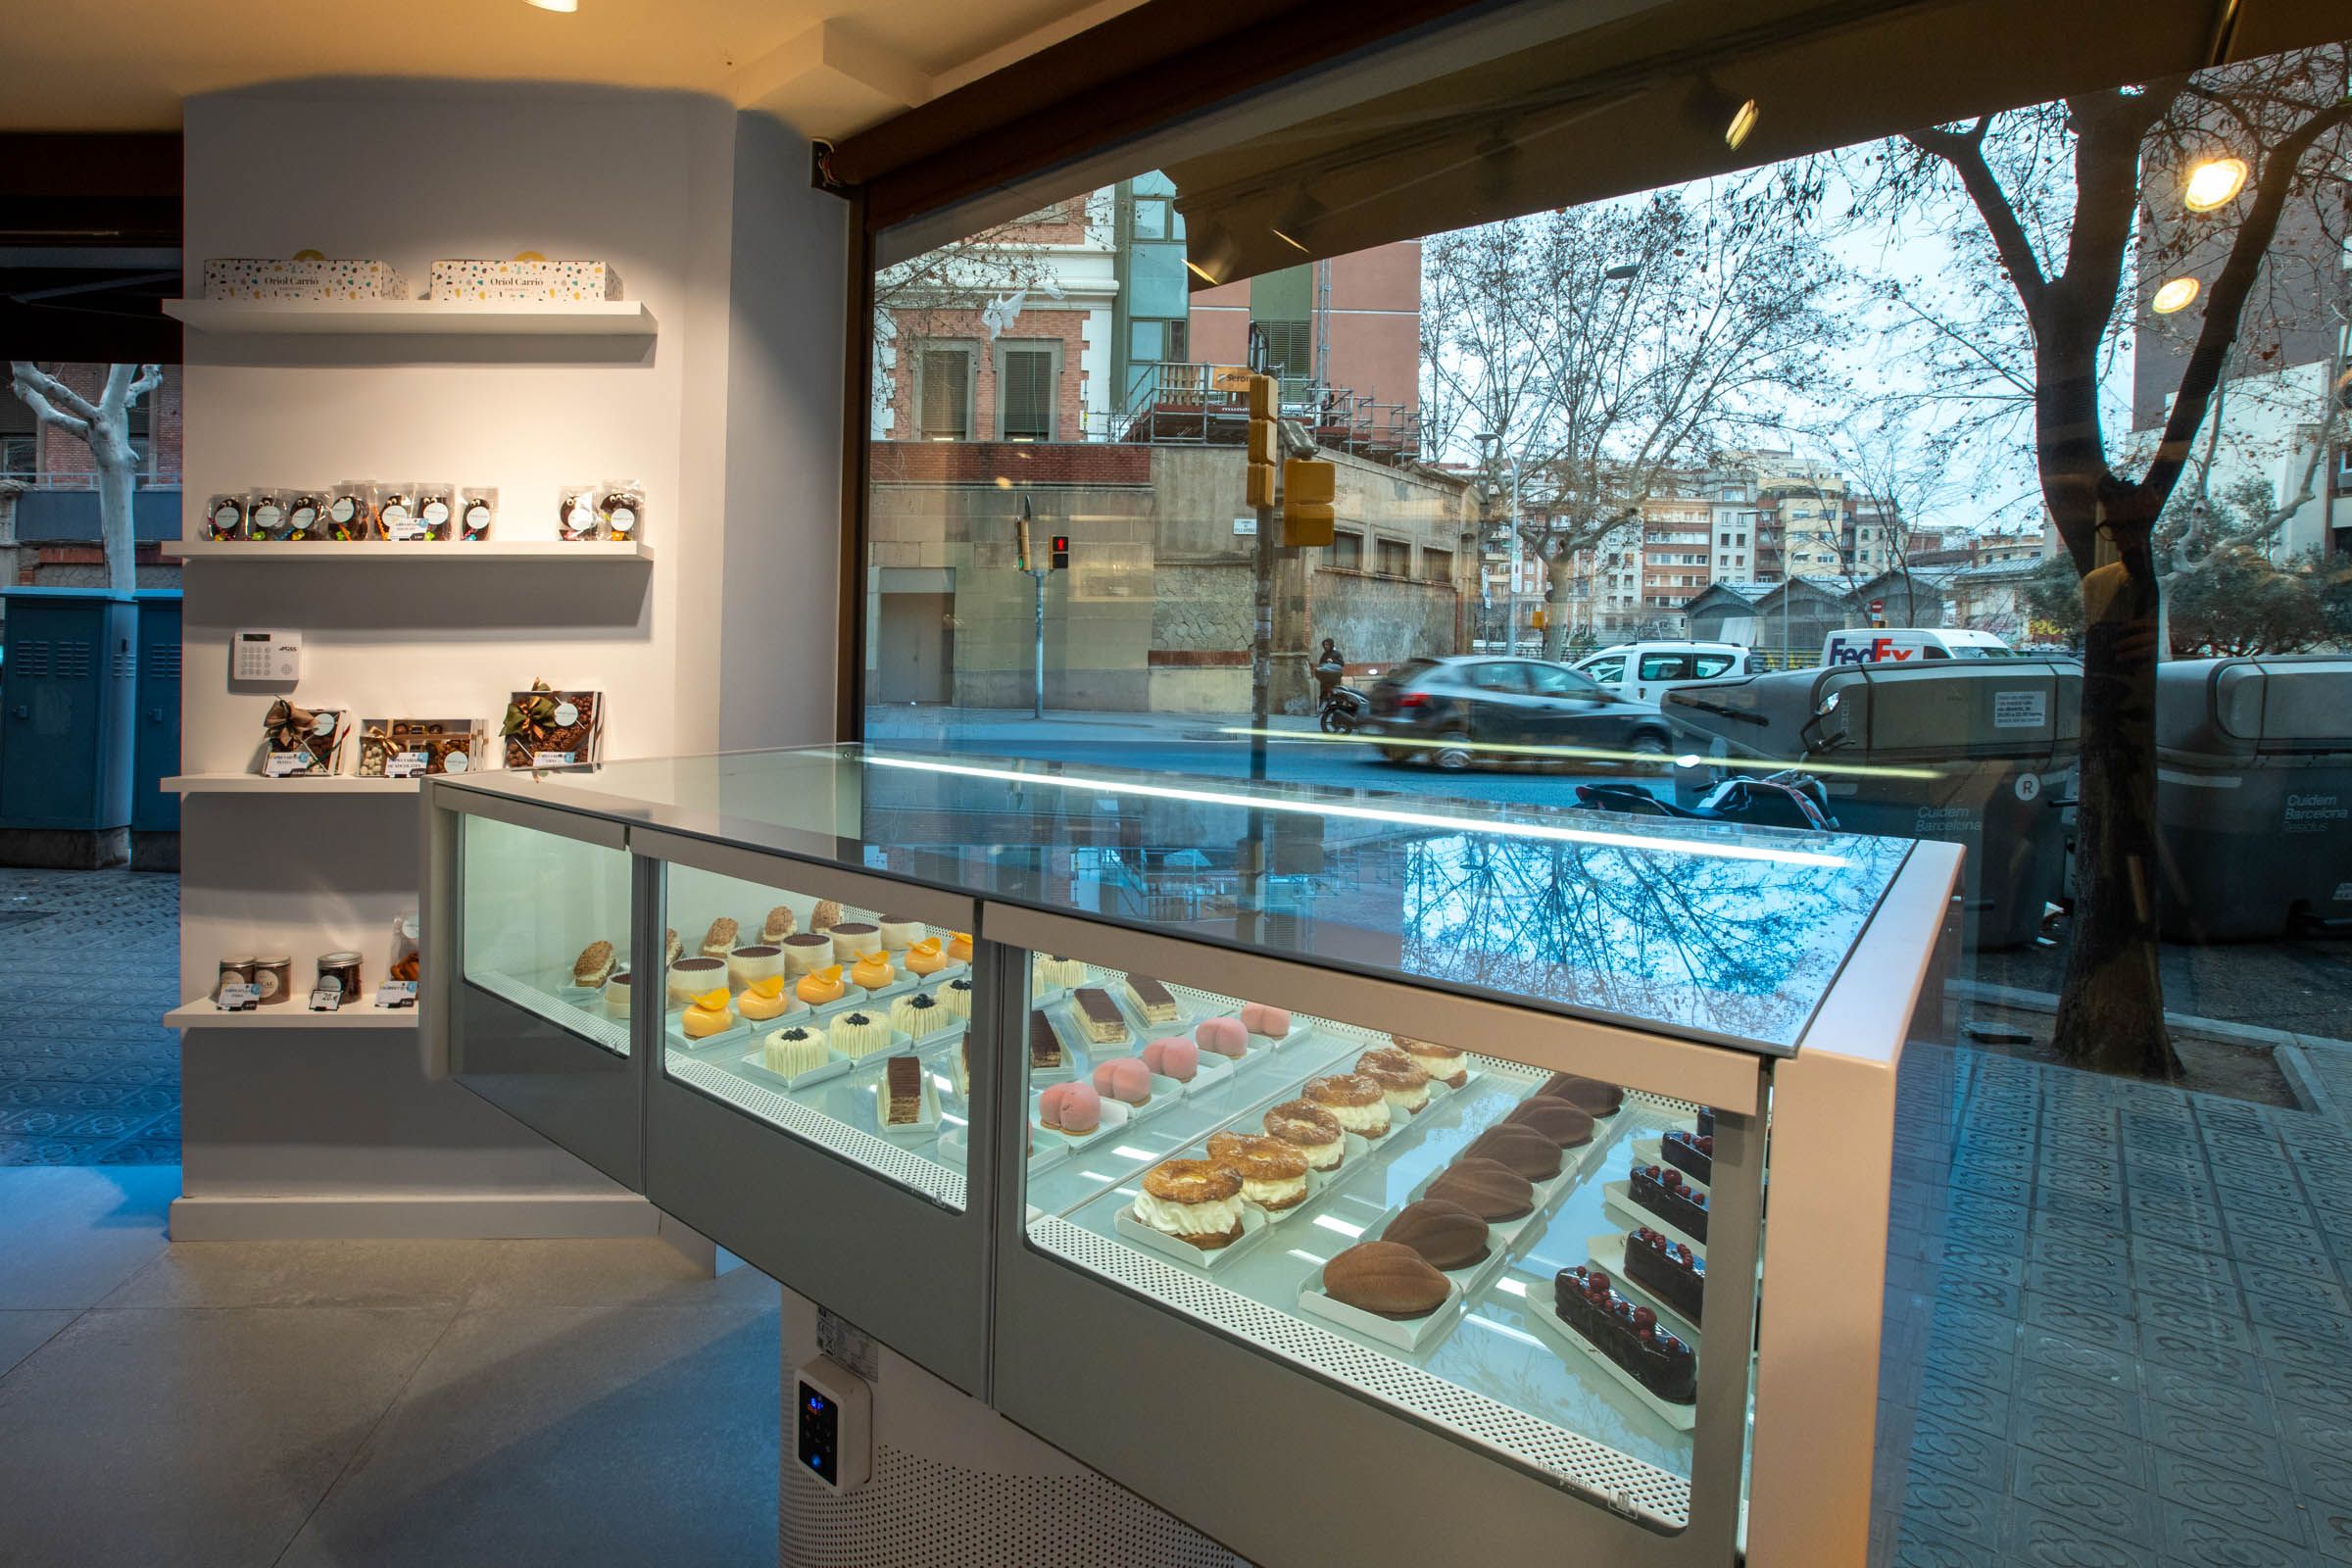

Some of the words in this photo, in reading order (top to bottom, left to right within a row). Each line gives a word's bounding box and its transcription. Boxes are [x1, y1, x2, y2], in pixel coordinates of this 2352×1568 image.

[265, 276, 288, 285] Oriol
[490, 277, 514, 286] Oriol
[2022, 780, 2034, 794] R
[2287, 794, 2337, 807] Cuidem
[1917, 805, 1970, 818] Cuidem
[2284, 808, 2348, 820] Barcelona
[1915, 818, 1982, 831] Barcelona
[1536, 1459, 1592, 1490] TEMPERED
